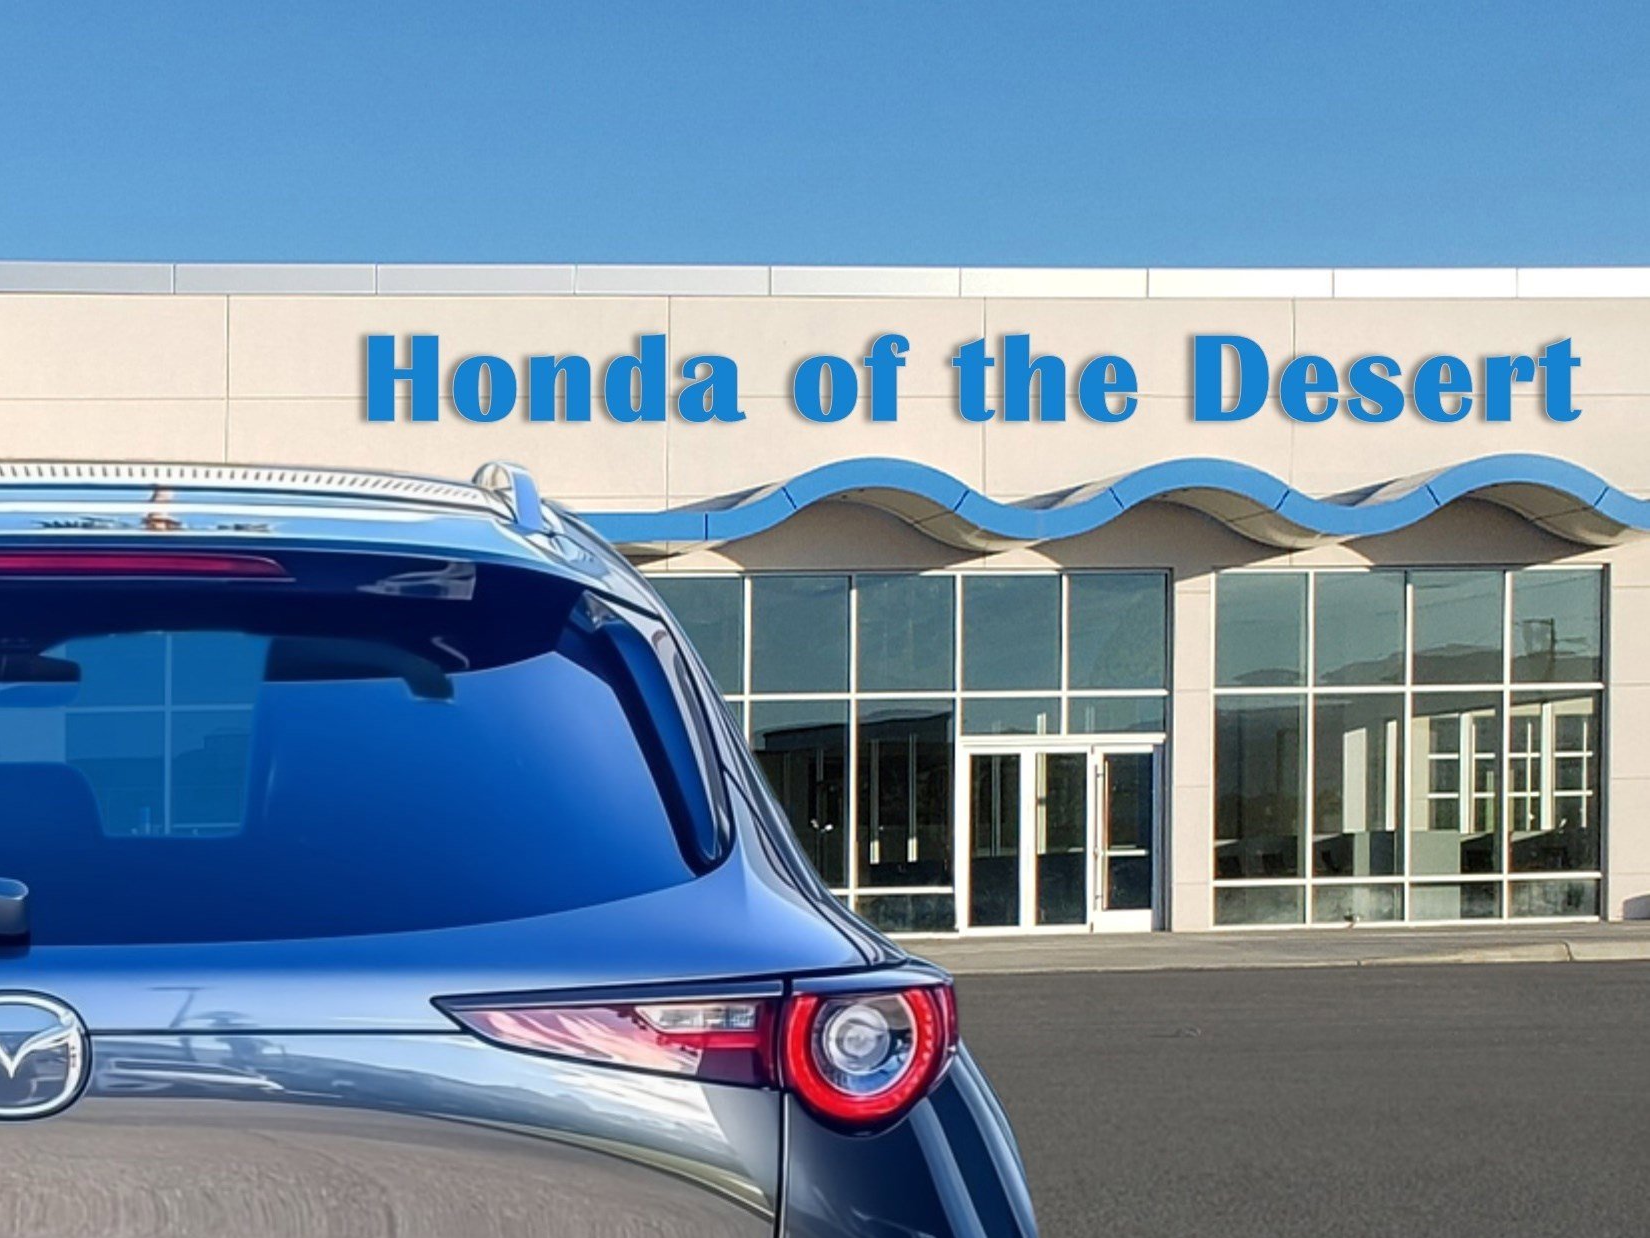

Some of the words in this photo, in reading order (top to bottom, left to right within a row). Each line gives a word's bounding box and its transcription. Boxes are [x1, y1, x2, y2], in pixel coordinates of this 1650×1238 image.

[366, 333, 747, 424] Honda
[793, 333, 911, 424] of
[952, 333, 1139, 424] the
[1194, 334, 1582, 424] Desert
